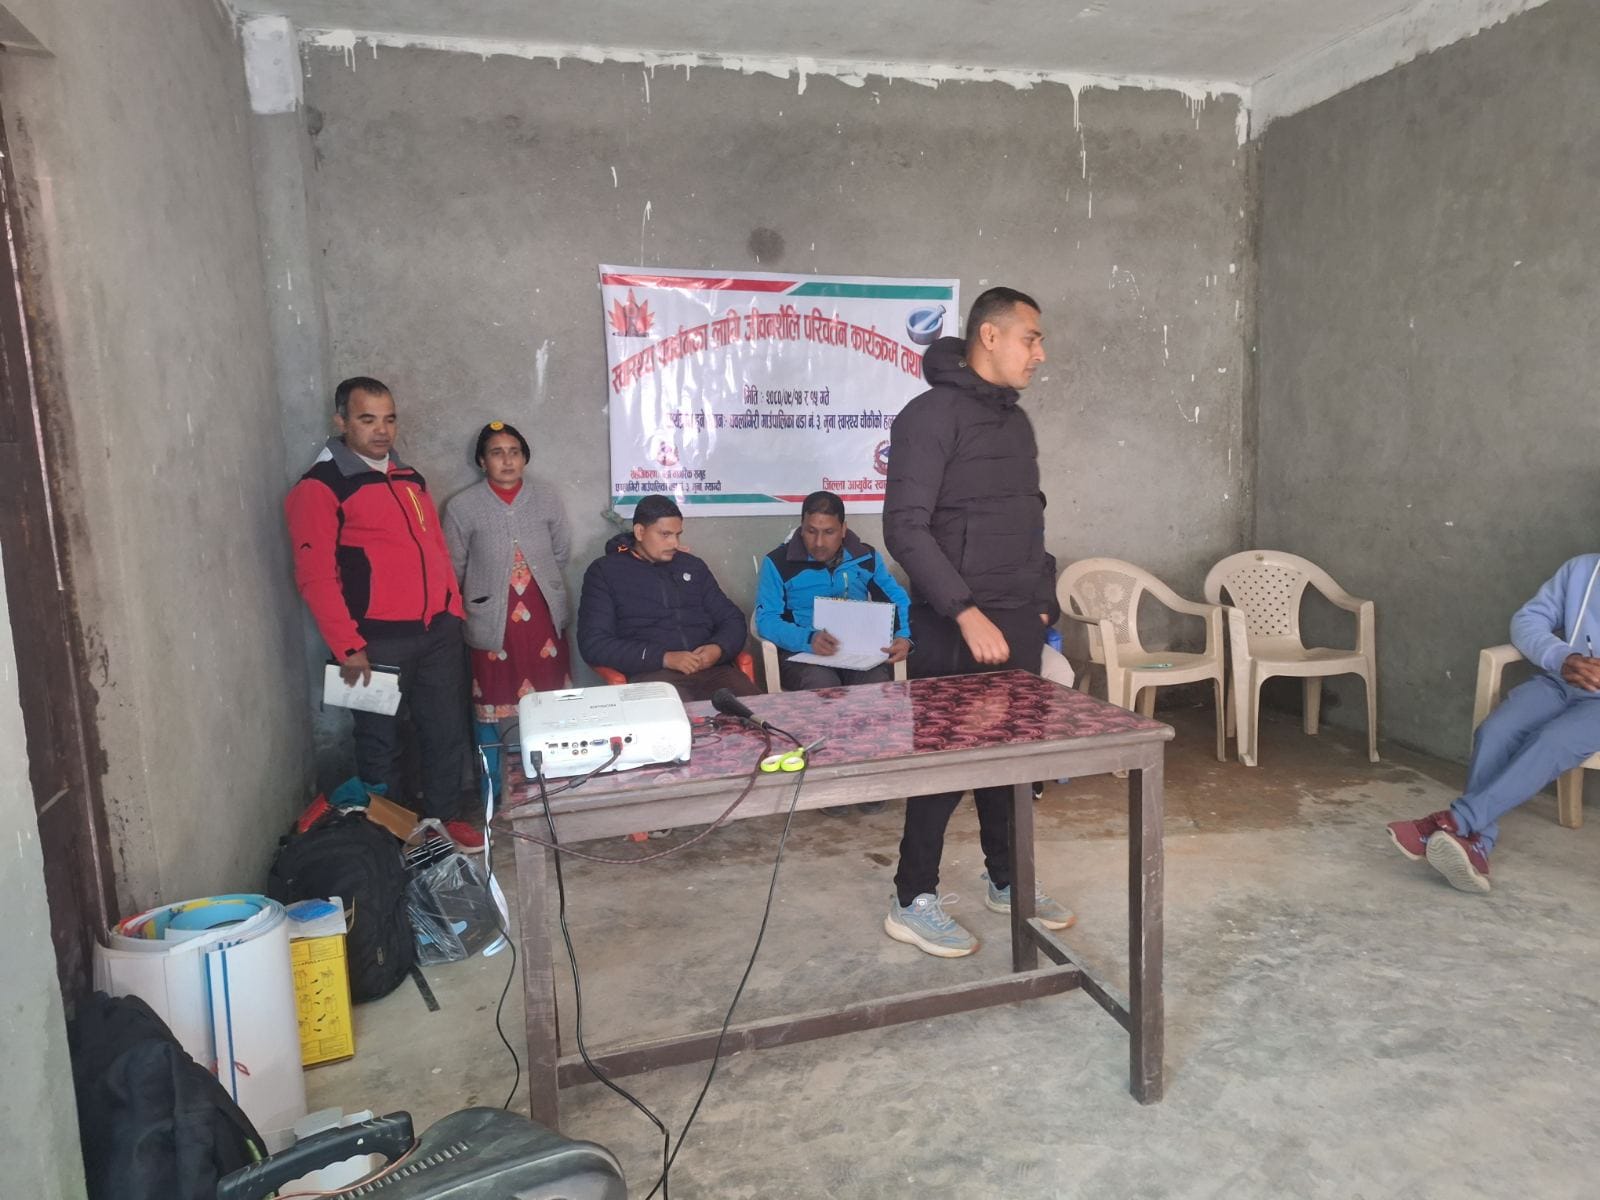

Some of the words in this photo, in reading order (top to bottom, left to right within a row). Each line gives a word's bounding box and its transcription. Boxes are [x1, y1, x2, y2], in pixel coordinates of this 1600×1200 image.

[711, 308, 741, 347] लागि
[803, 307, 848, 348] परिवर्तन
[850, 324, 899, 367] कार्यक्रम
[901, 345, 923, 380] तथा
[819, 386, 830, 406] गते
[823, 414, 836, 433] मुना
[837, 414, 858, 430] स्वास्थ्य
[822, 477, 846, 490] जिल्ला
[847, 476, 872, 493] आयुर्वेद
